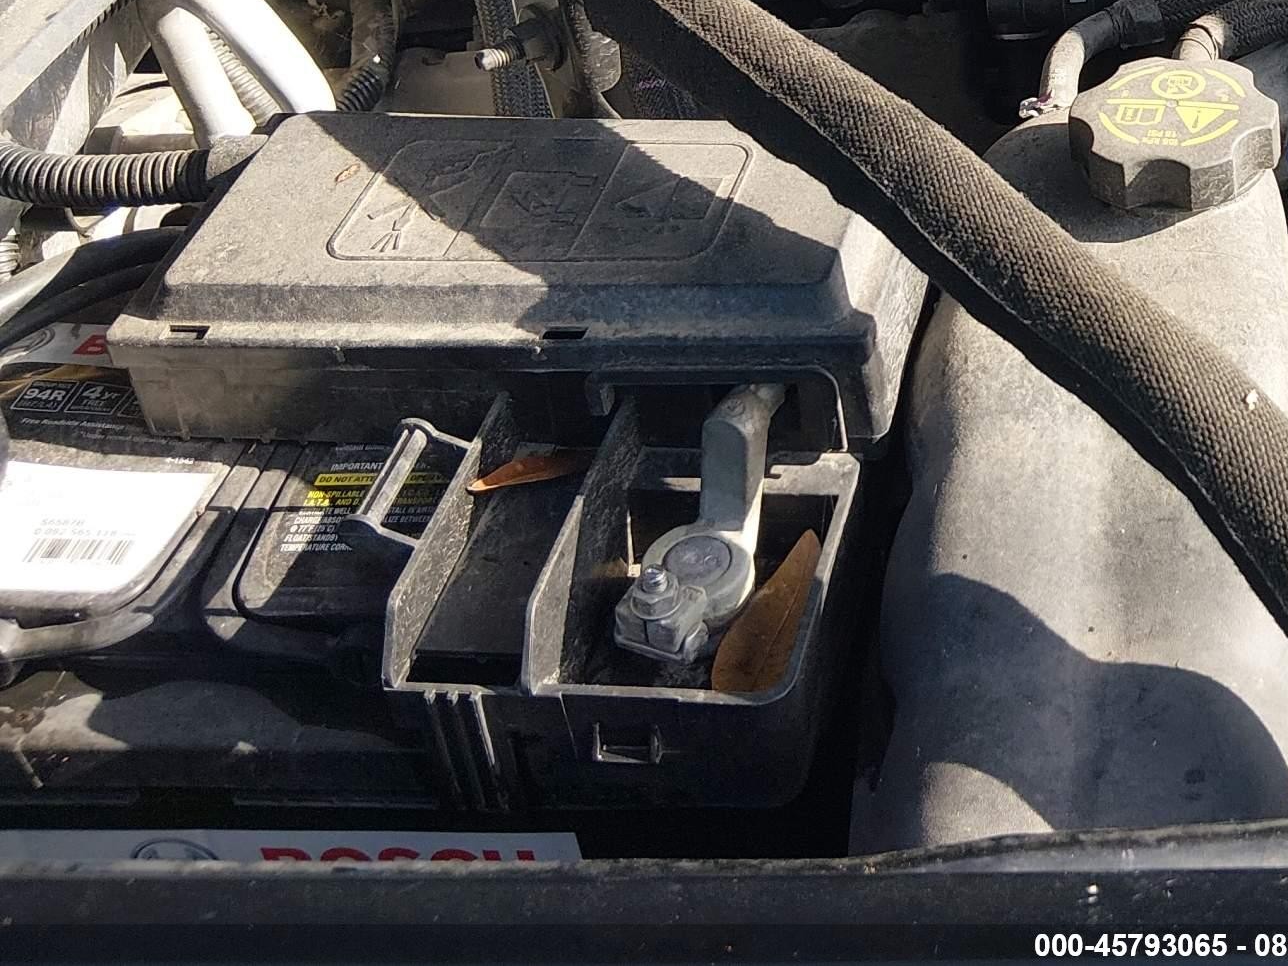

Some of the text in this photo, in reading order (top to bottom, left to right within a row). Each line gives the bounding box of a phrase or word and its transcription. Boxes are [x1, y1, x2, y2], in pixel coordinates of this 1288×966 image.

[22, 387, 67, 402] 94R
[318, 475, 334, 483] DO
[334, 475, 353, 483] NOT
